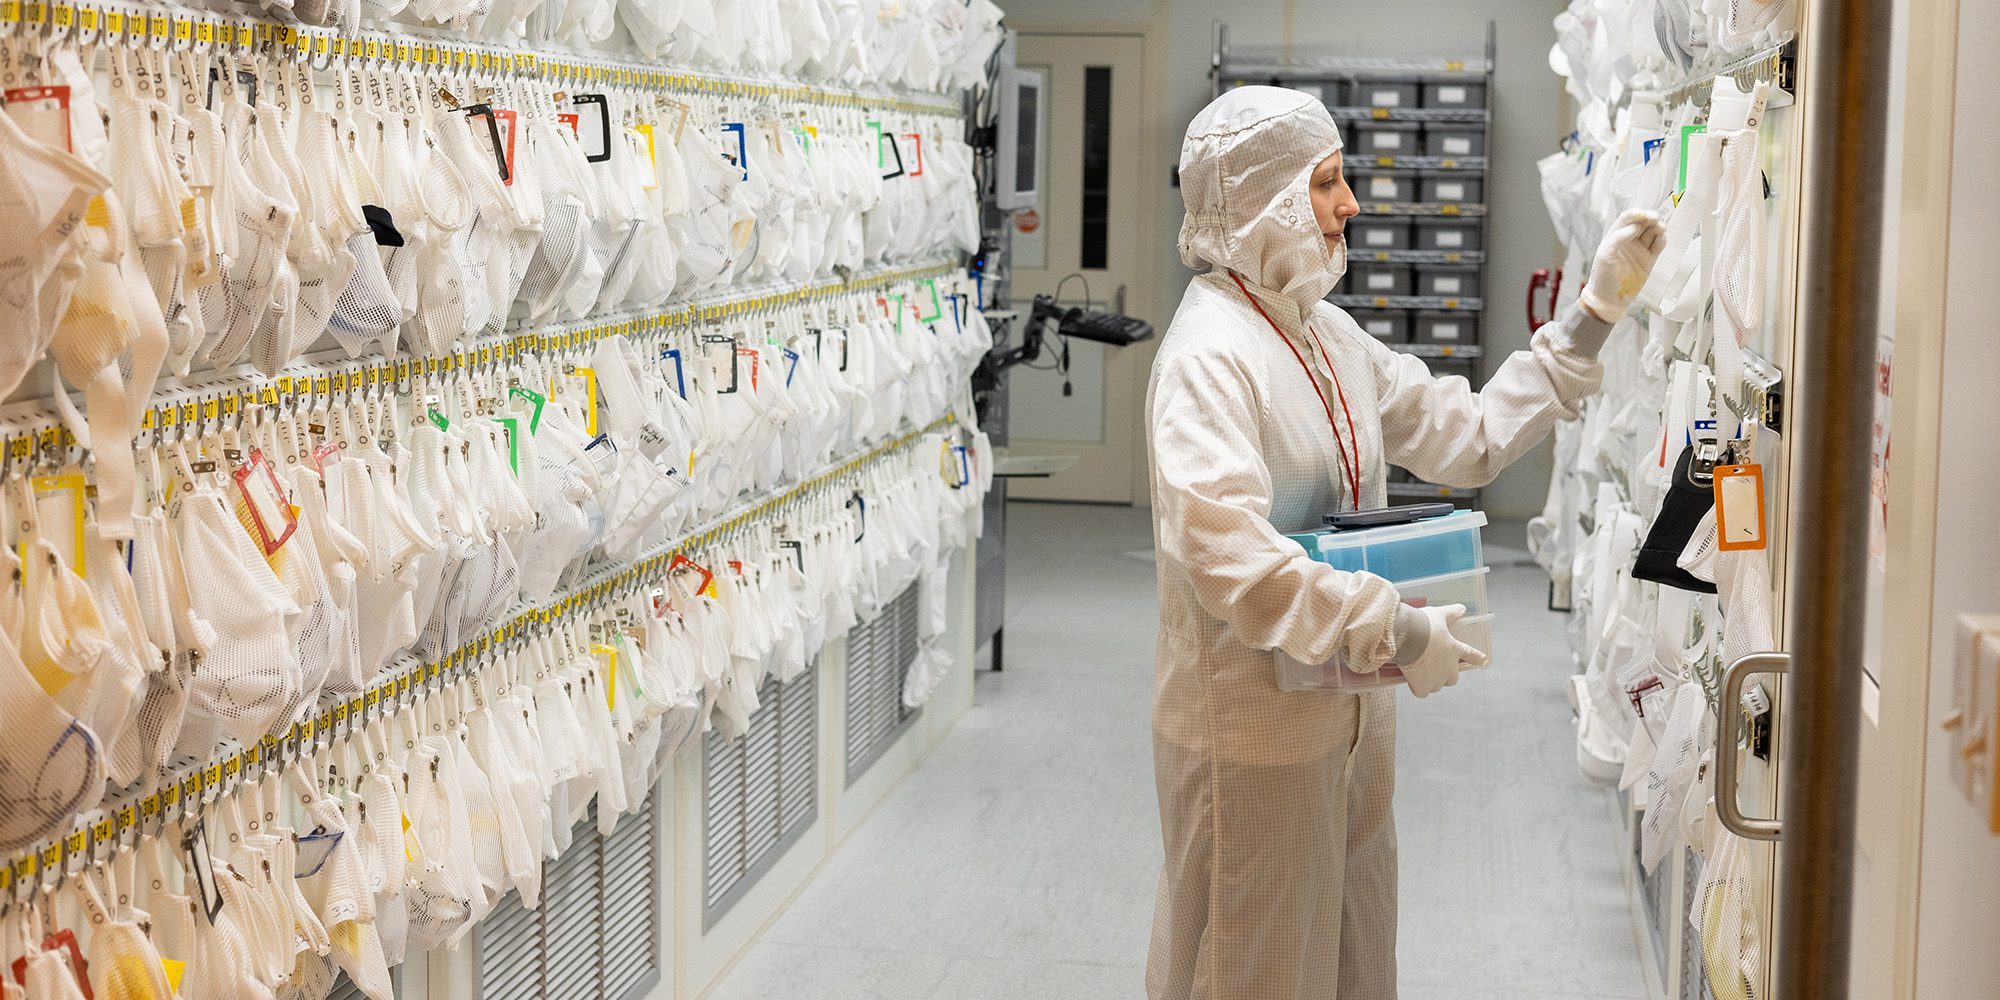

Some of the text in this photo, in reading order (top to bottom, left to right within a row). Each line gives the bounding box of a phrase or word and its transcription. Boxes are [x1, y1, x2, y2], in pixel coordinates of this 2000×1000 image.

[55, 6, 68, 25] 109
[81, 10, 92, 28] 110
[108, 14, 117, 32] 111
[130, 16, 141, 34] 112
[153, 18, 163, 36] 113
[176, 21, 186, 38] 114
[198, 24, 208, 41] 115
[219, 26, 229, 43] 116
[239, 28, 248, 45] 117
[367, 43, 374, 57] 24
[383, 44, 390, 59] 25
[56, 211, 80, 236] 105
[279, 378, 288, 393] 221
[298, 377, 308, 395] 222
[317, 379, 326, 394] 223
[334, 375, 343, 392] 224
[183, 404, 192, 421] 216
[204, 401, 214, 418] 217
[224, 397, 233, 414] 218
[162, 408, 171, 426] 215
[12, 438, 27, 457] 209
[245, 748, 254, 766] 321
[225, 757, 237, 777] 320
[206, 767, 217, 786] 319
[185, 776, 196, 797] 318
[164, 787, 174, 807] 317
[143, 798, 154, 817] 316
[119, 809, 131, 830] 315
[95, 821, 107, 842] 314
[68, 833, 80, 854] 313
[43, 845, 56, 867] 312
